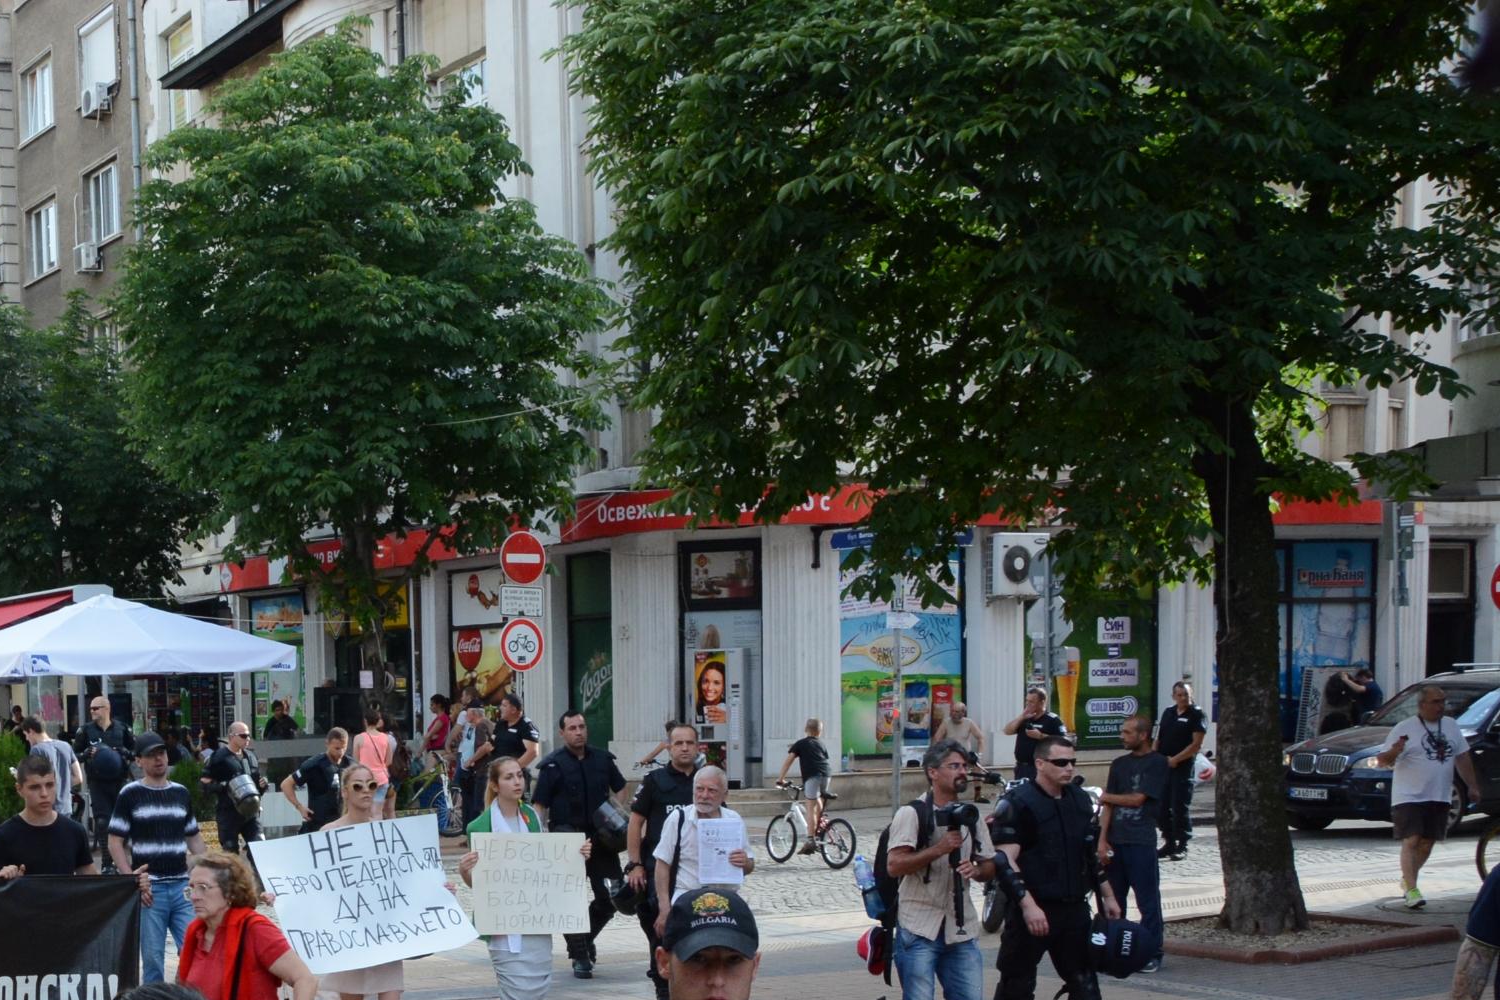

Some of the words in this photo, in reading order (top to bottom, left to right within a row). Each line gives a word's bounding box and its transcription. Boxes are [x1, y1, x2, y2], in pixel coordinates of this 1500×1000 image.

[1108, 702, 1125, 712] EDGE
[308, 826, 363, 869] НЕ
[370, 821, 410, 855] НА
[482, 867, 585, 893] ТОЛЕРАНТЕН
[333, 891, 374, 924] ДА
[377, 881, 411, 911] НА
[287, 906, 462, 960] ПРАВОСЛАВИЕТО
[495, 912, 585, 931] НОРМАЛЕН
[690, 915, 738, 928] BULGARIA
